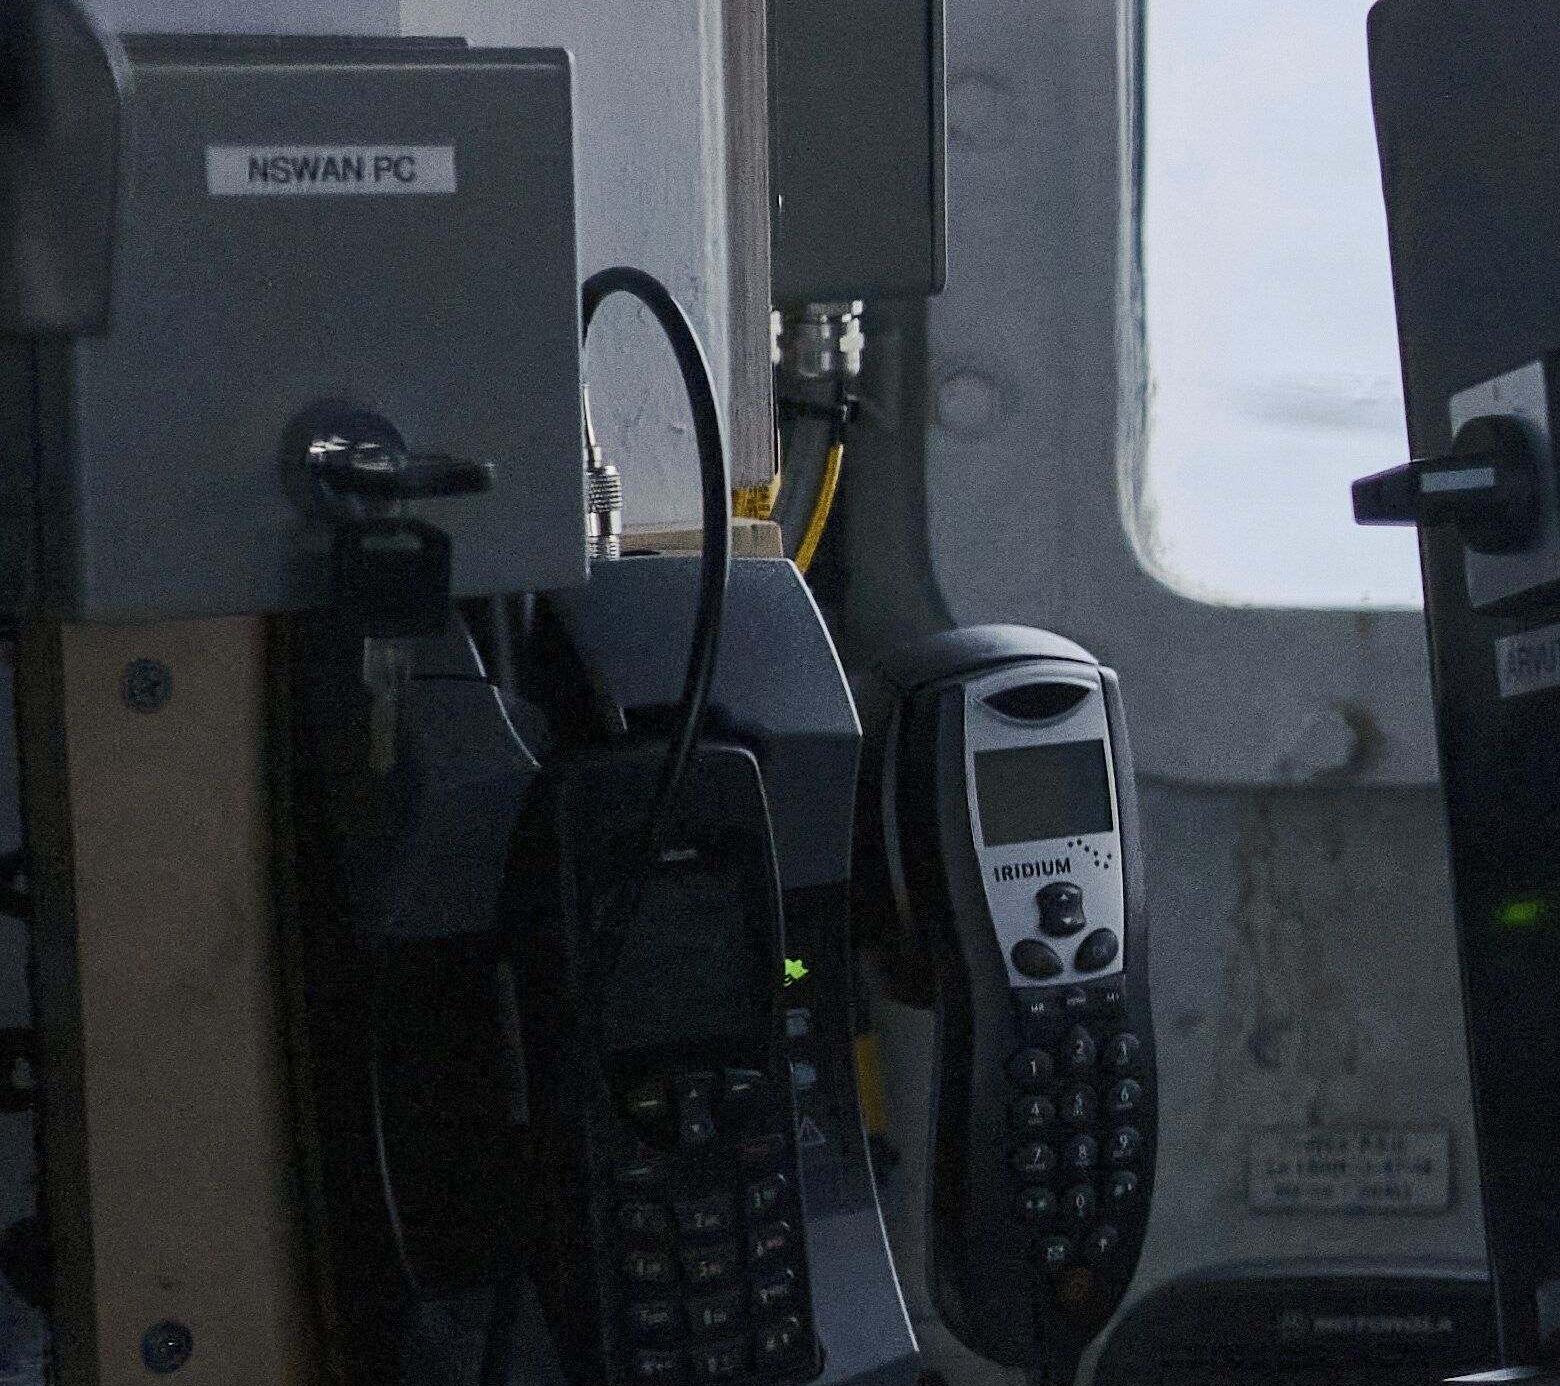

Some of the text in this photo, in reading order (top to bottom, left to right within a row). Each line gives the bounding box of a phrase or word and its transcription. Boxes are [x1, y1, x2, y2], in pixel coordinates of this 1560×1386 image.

[249, 155, 416, 183] NSWAN PC
[994, 859, 1071, 882] IRIDIUM
